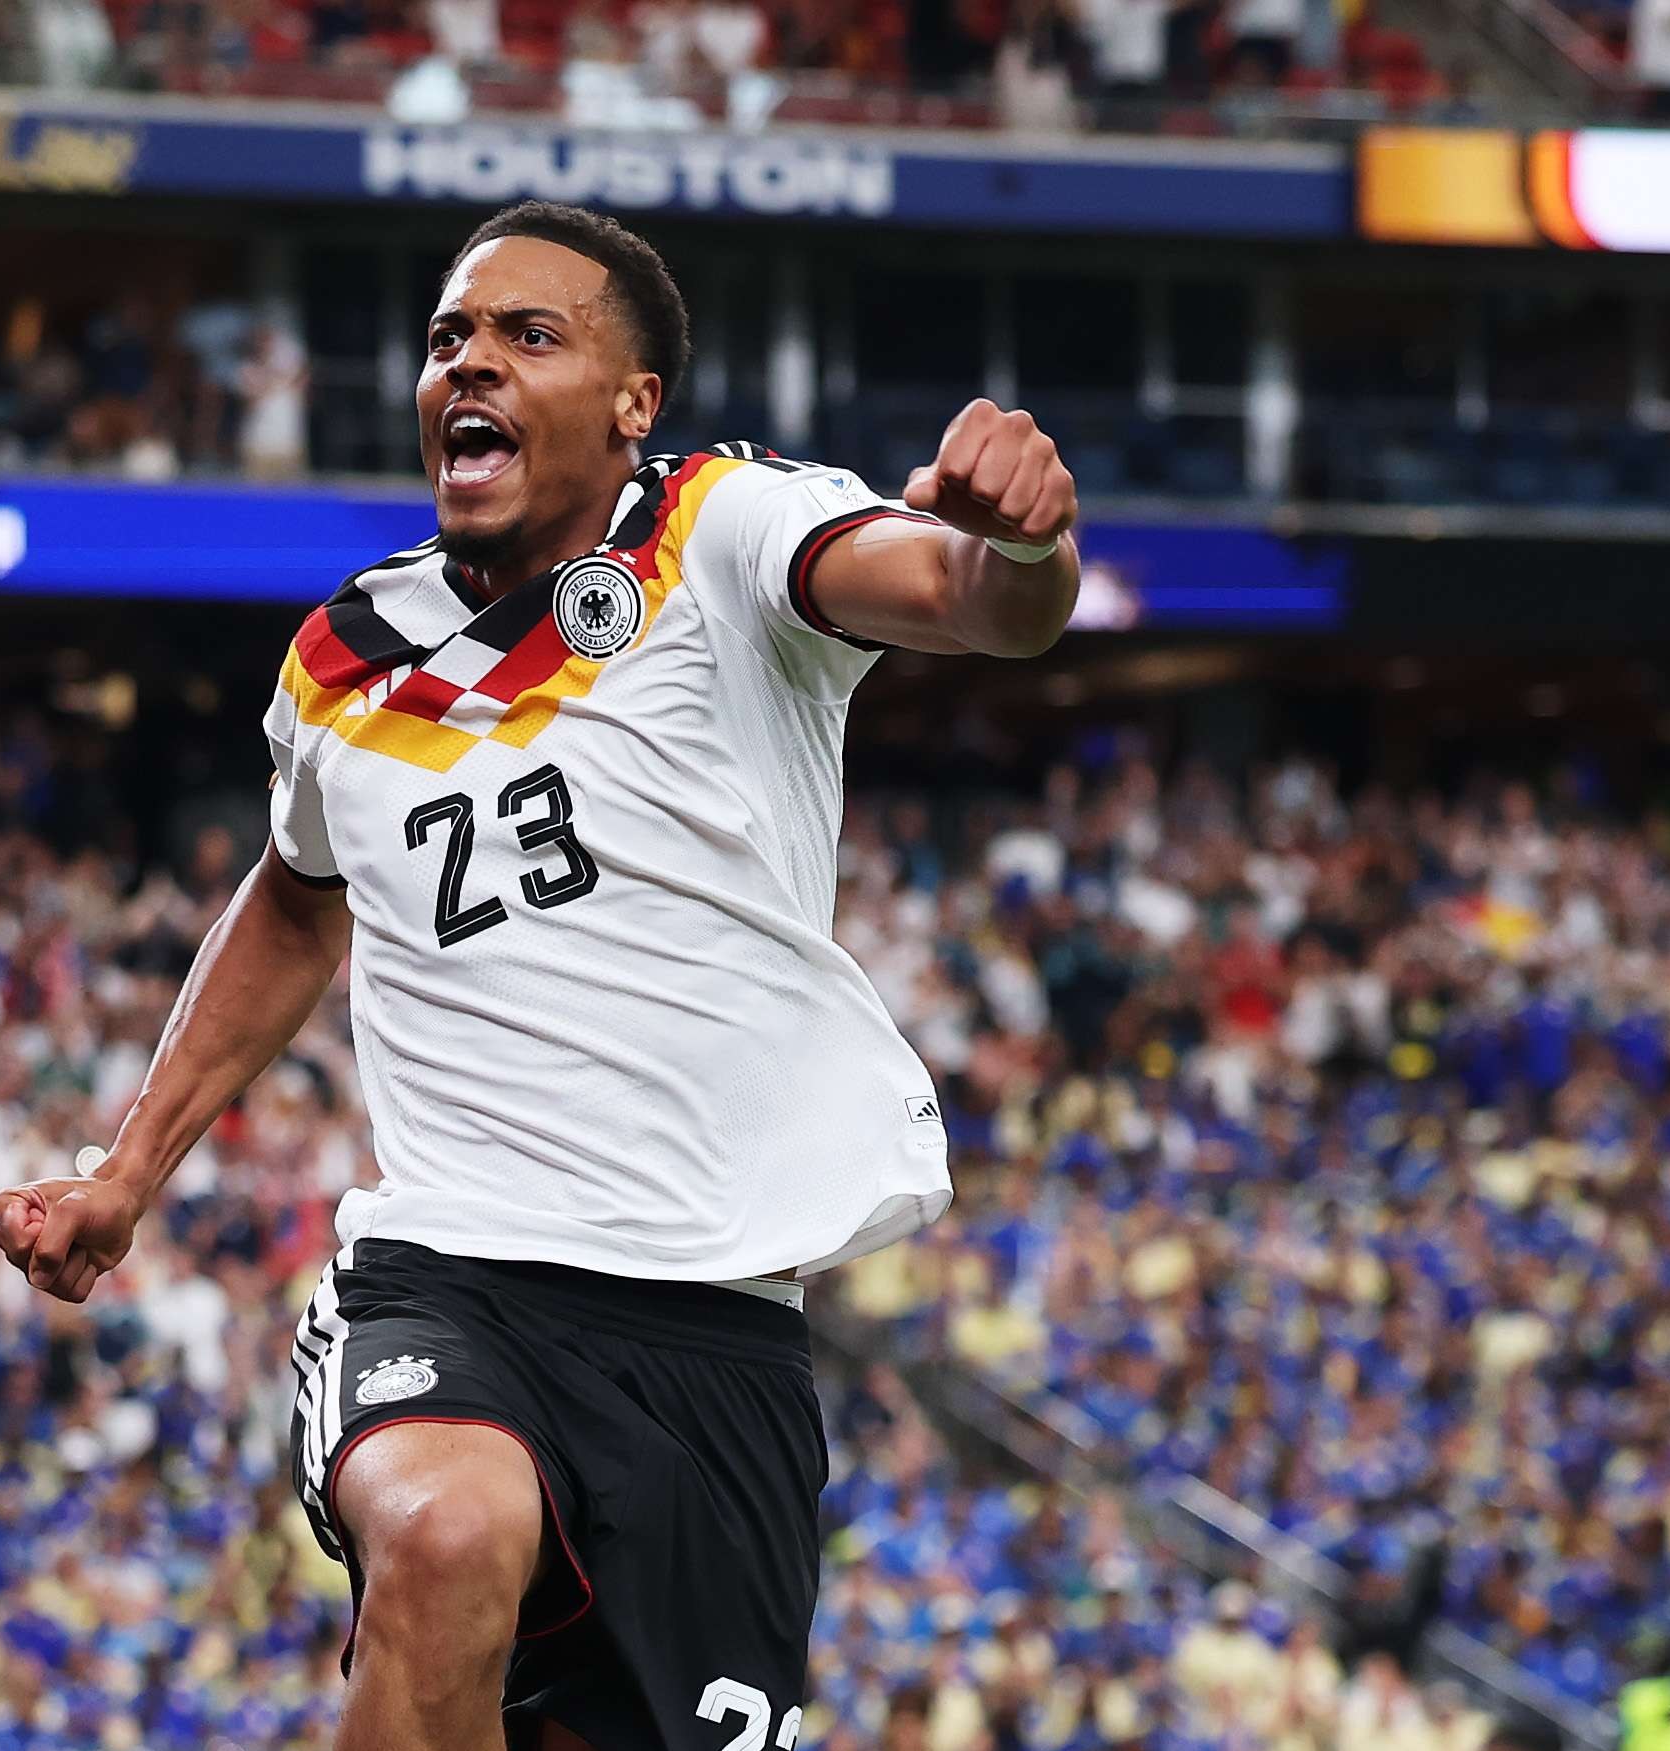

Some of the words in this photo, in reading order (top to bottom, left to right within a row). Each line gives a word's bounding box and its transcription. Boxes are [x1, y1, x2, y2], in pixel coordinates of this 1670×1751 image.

[363, 127, 893, 217] HOUSTON
[570, 574, 618, 595] DEUTSCHER
[571, 616, 628, 646] FUSSBALL-BUND
[404, 763, 600, 949] 23
